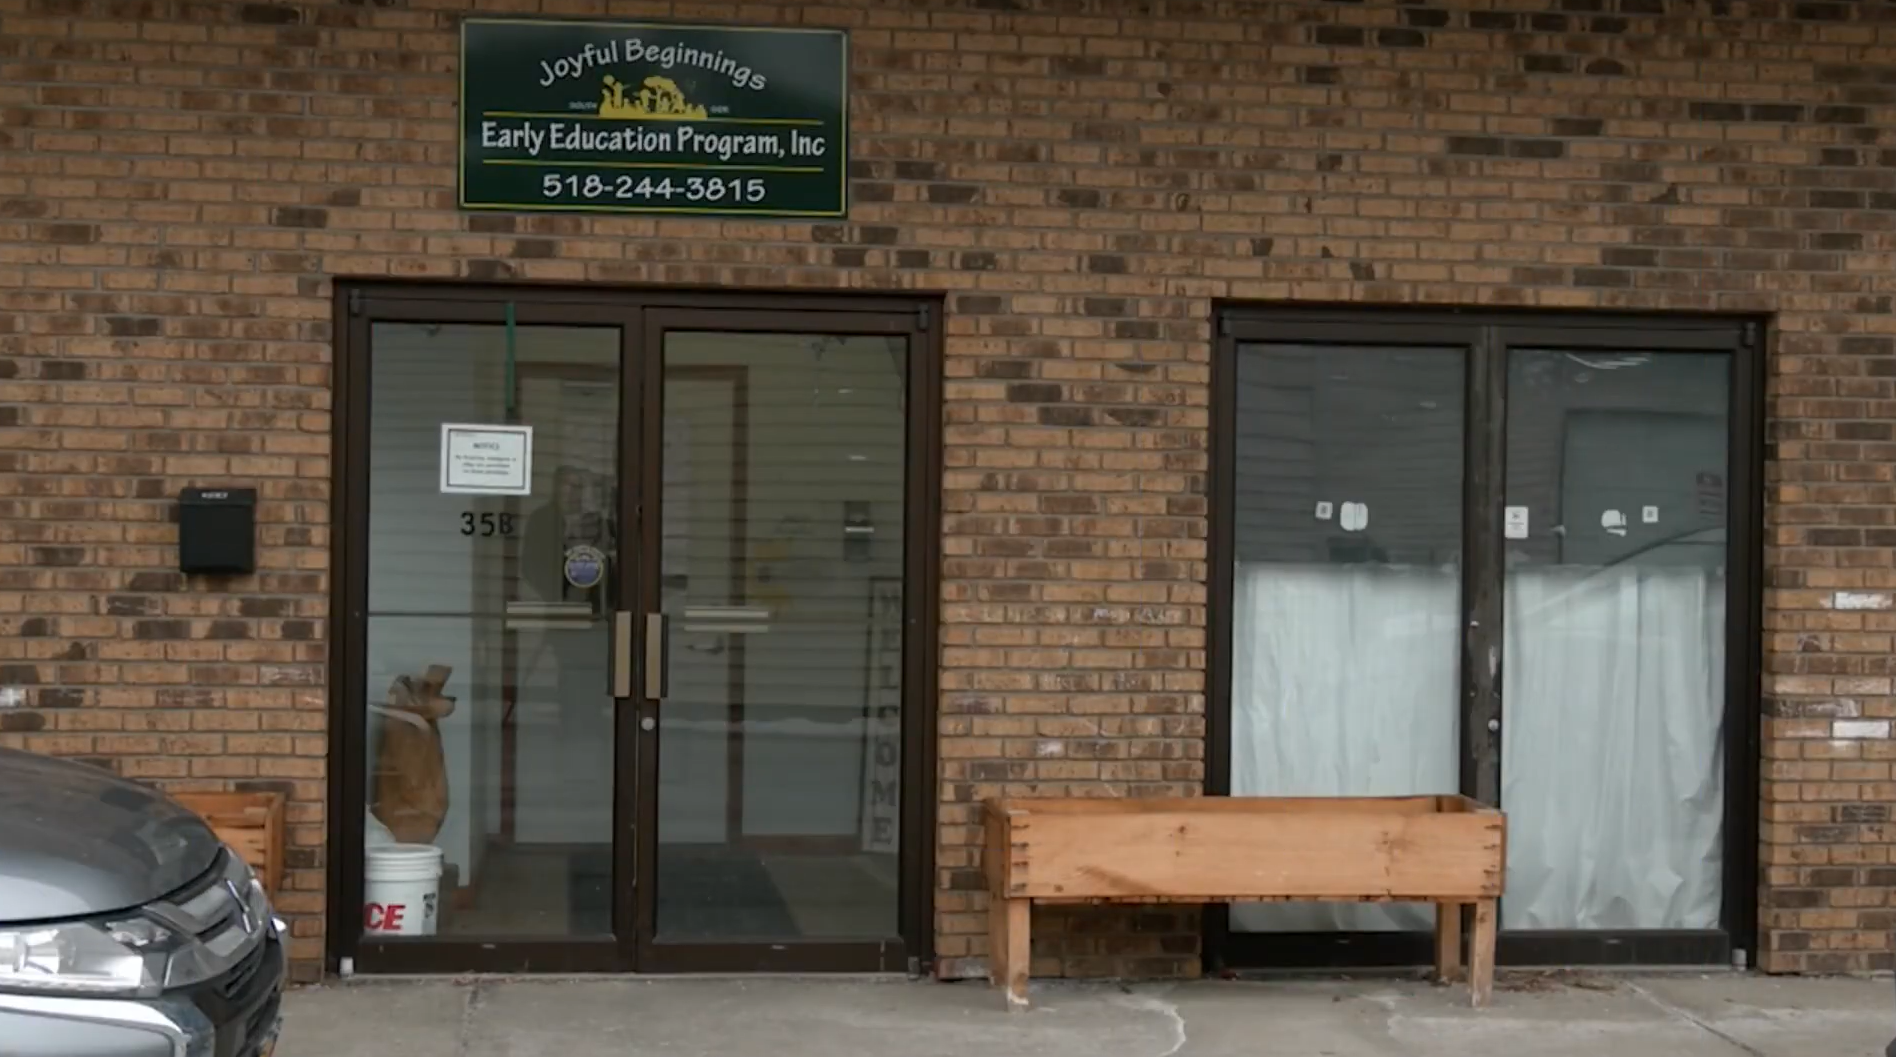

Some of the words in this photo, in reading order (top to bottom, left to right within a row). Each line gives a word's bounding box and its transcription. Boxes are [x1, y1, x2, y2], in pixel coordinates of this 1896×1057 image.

[538, 39, 619, 87] Joyful
[625, 37, 768, 91] Beginnings
[481, 121, 545, 156] Early
[549, 123, 672, 153] Education
[677, 125, 786, 161] Program,
[791, 129, 826, 156] Inc
[542, 173, 767, 202] 518-244-3815
[460, 511, 514, 537] 35B
